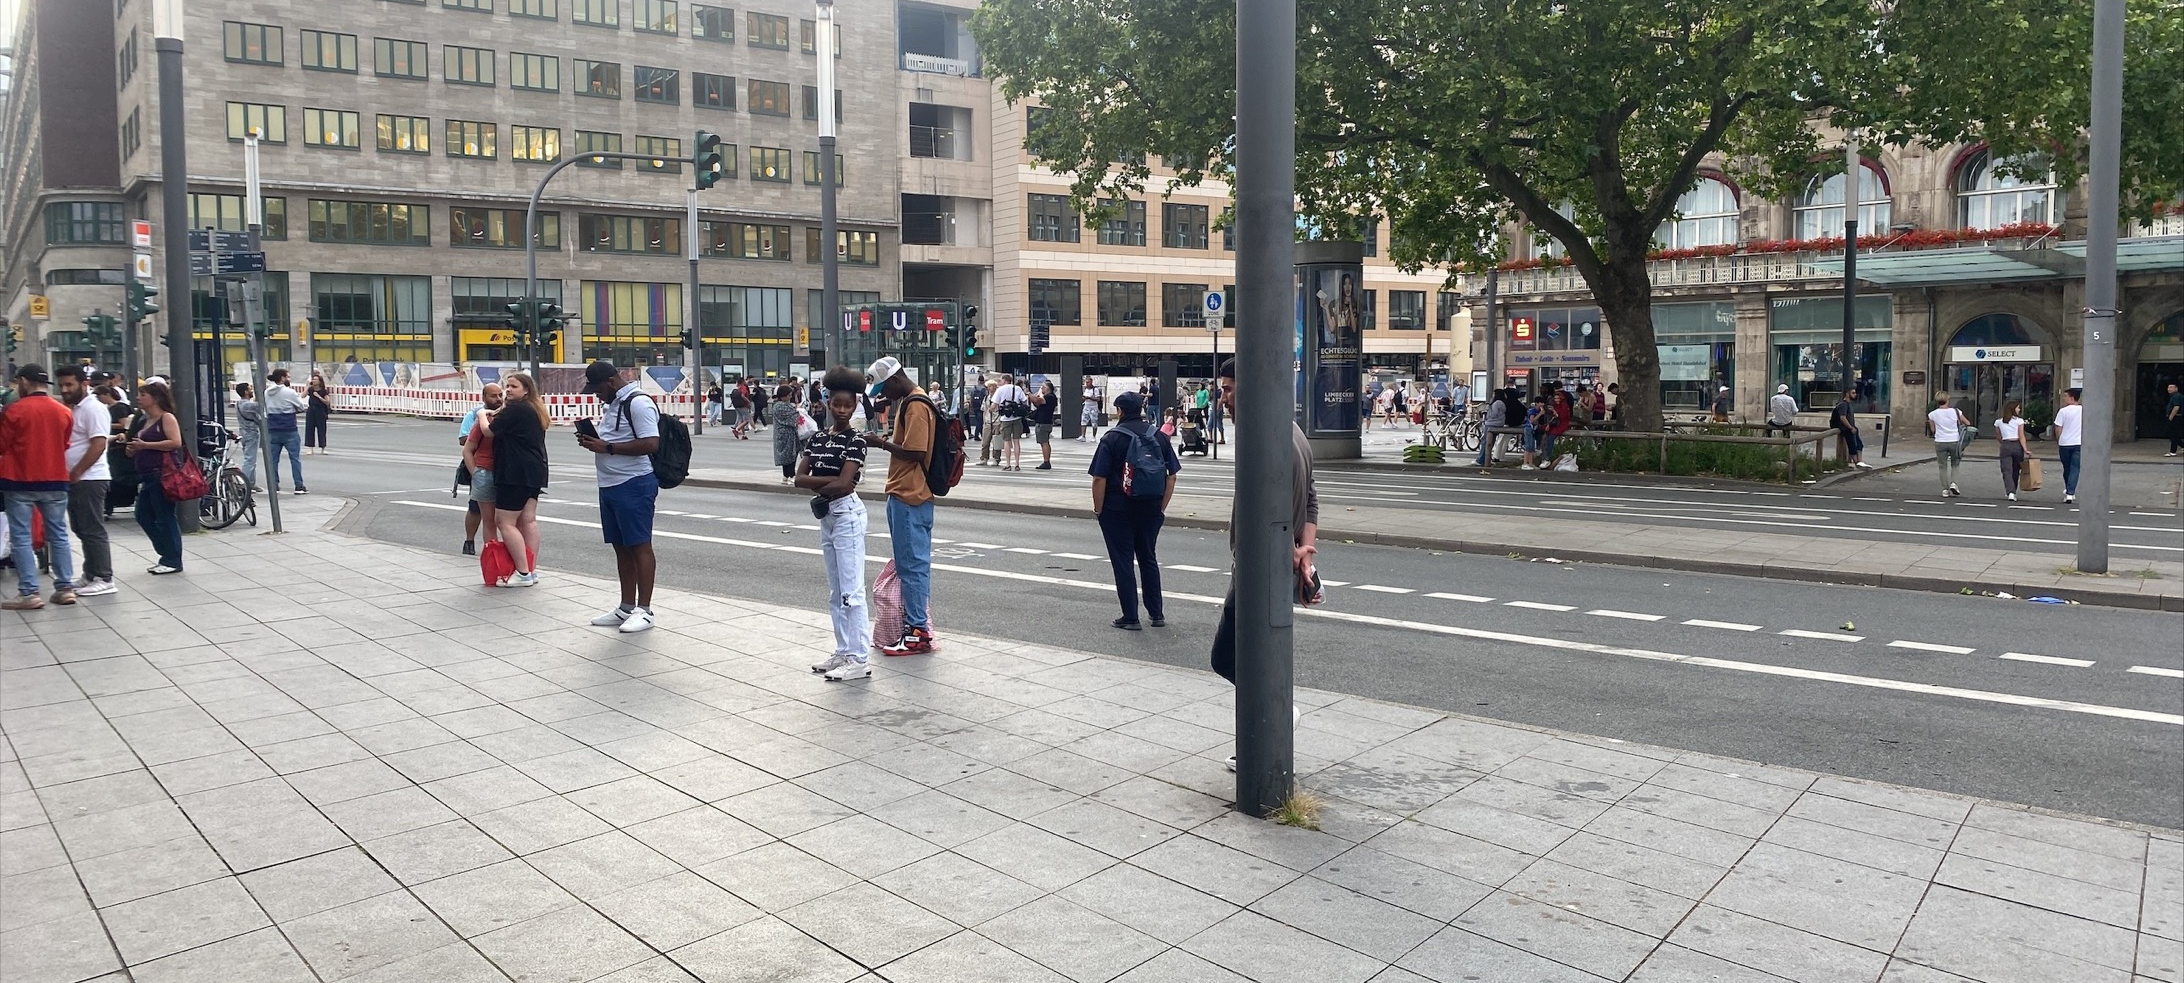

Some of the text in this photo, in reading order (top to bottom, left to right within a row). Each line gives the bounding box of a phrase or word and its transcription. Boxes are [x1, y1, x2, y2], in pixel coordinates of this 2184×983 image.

[844, 312, 852, 331] U
[892, 311, 907, 330] U
[926, 316, 944, 325] Tram
[2093, 331, 2100, 341] 5
